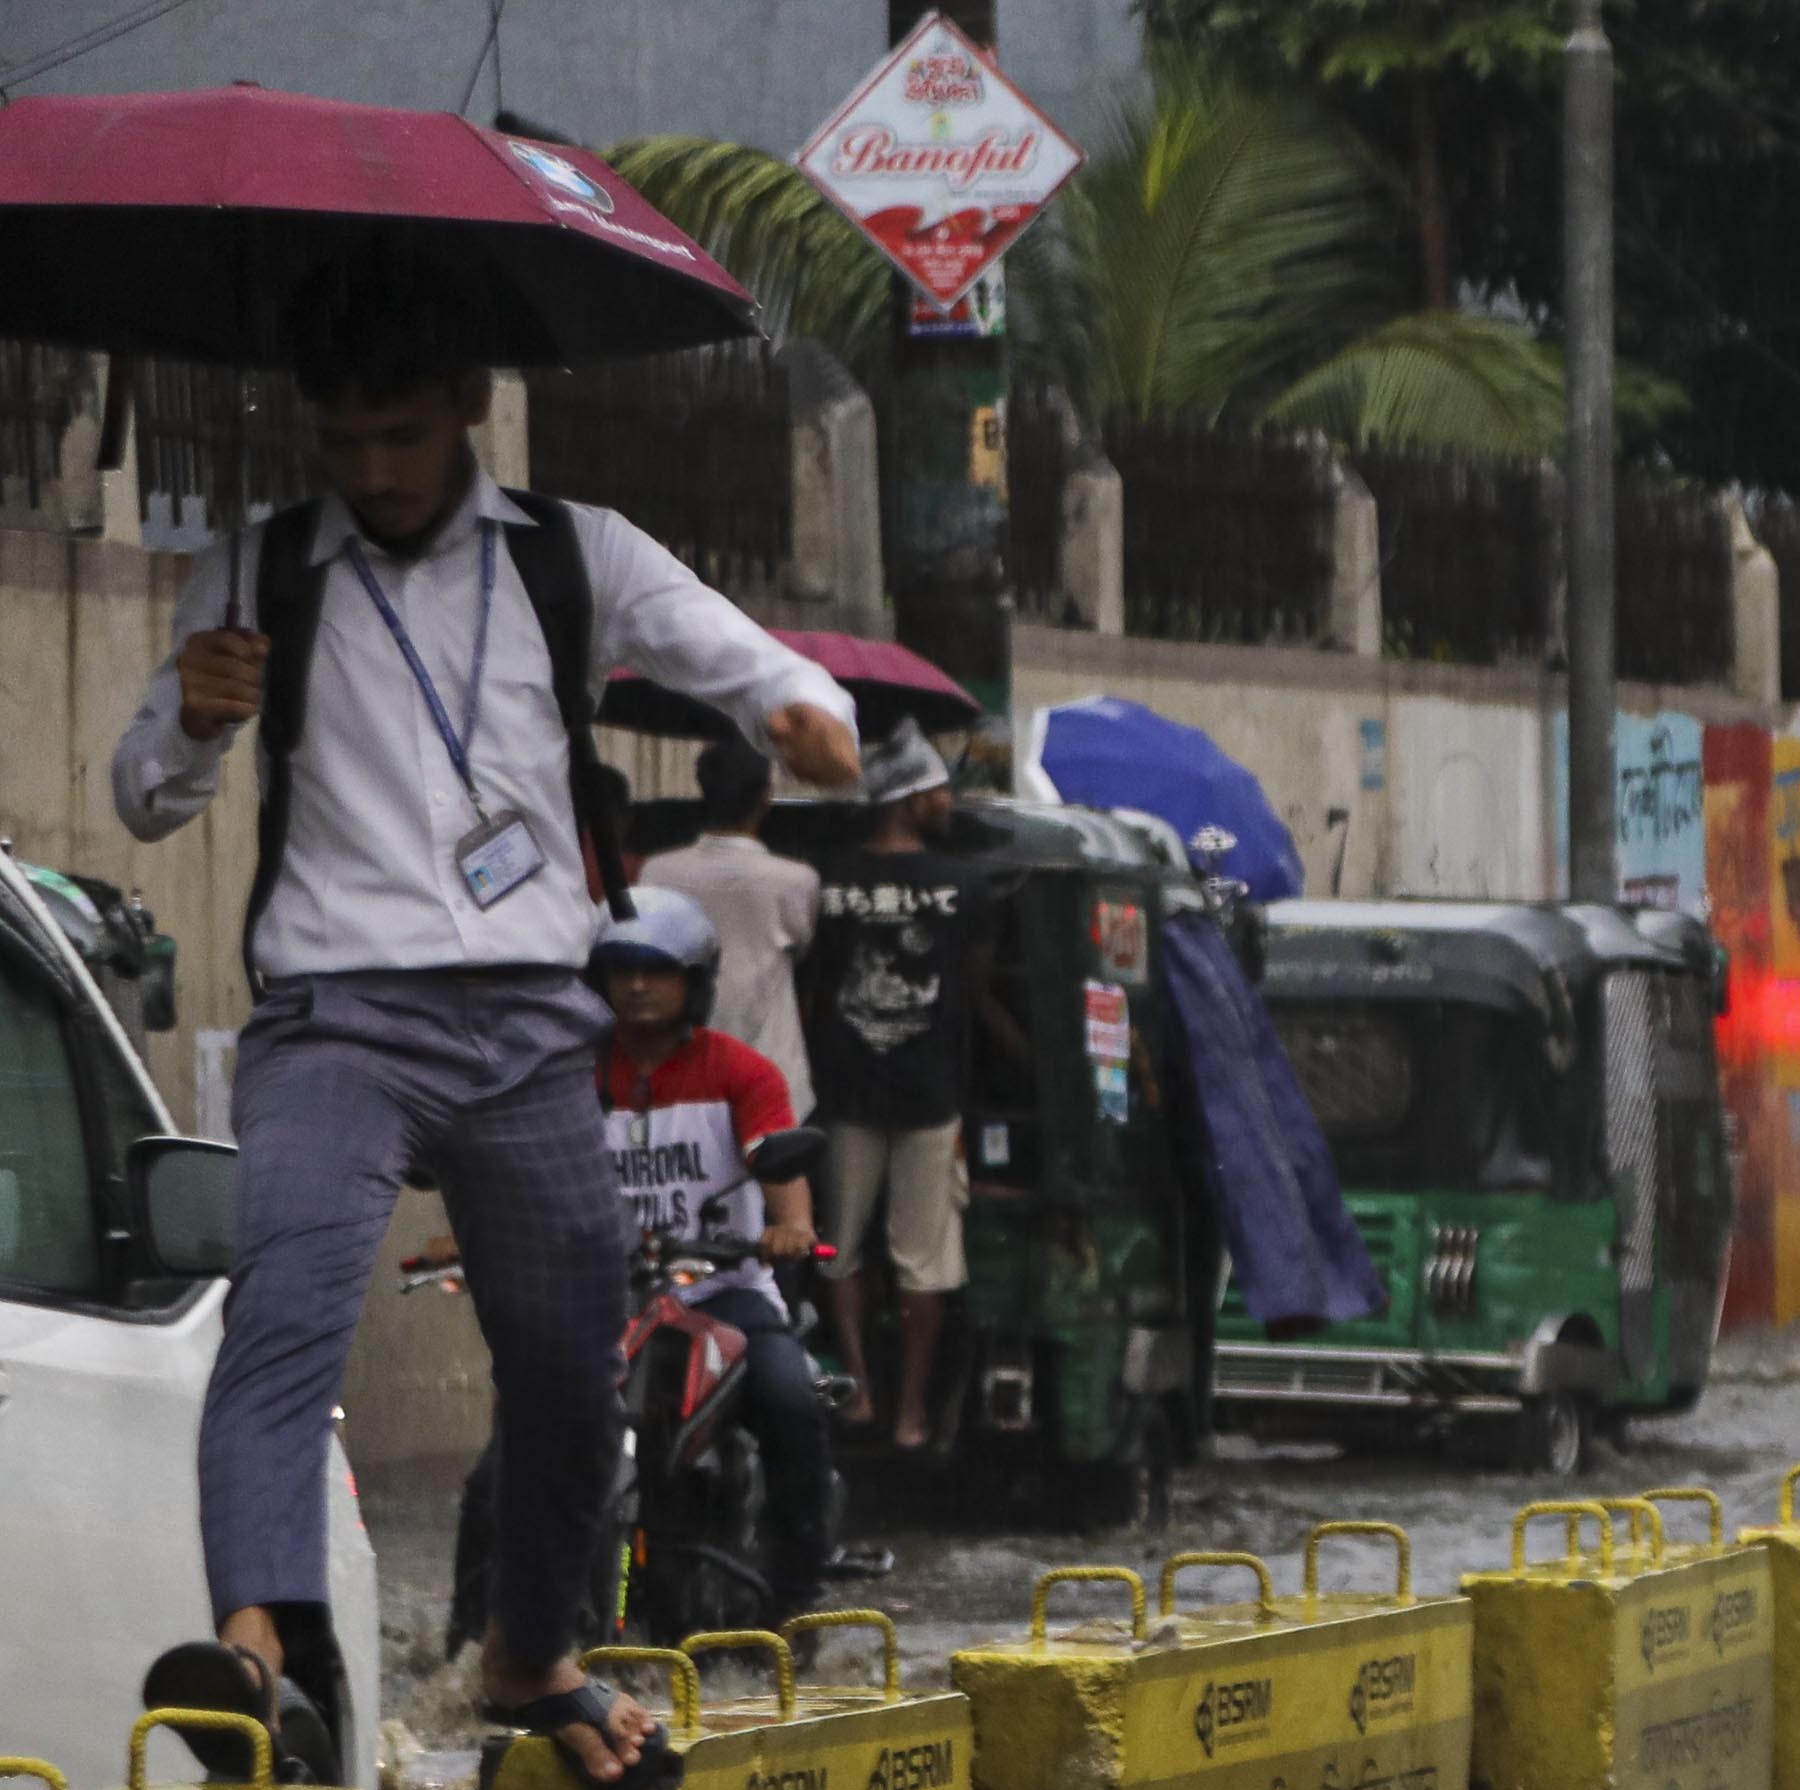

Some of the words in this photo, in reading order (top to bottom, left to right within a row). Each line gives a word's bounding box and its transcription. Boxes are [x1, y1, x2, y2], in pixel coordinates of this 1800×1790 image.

[832, 124, 1034, 186] Banoful
[1367, 1653, 1415, 1700] BSRM
[1217, 1678, 1272, 1727] BSRM
